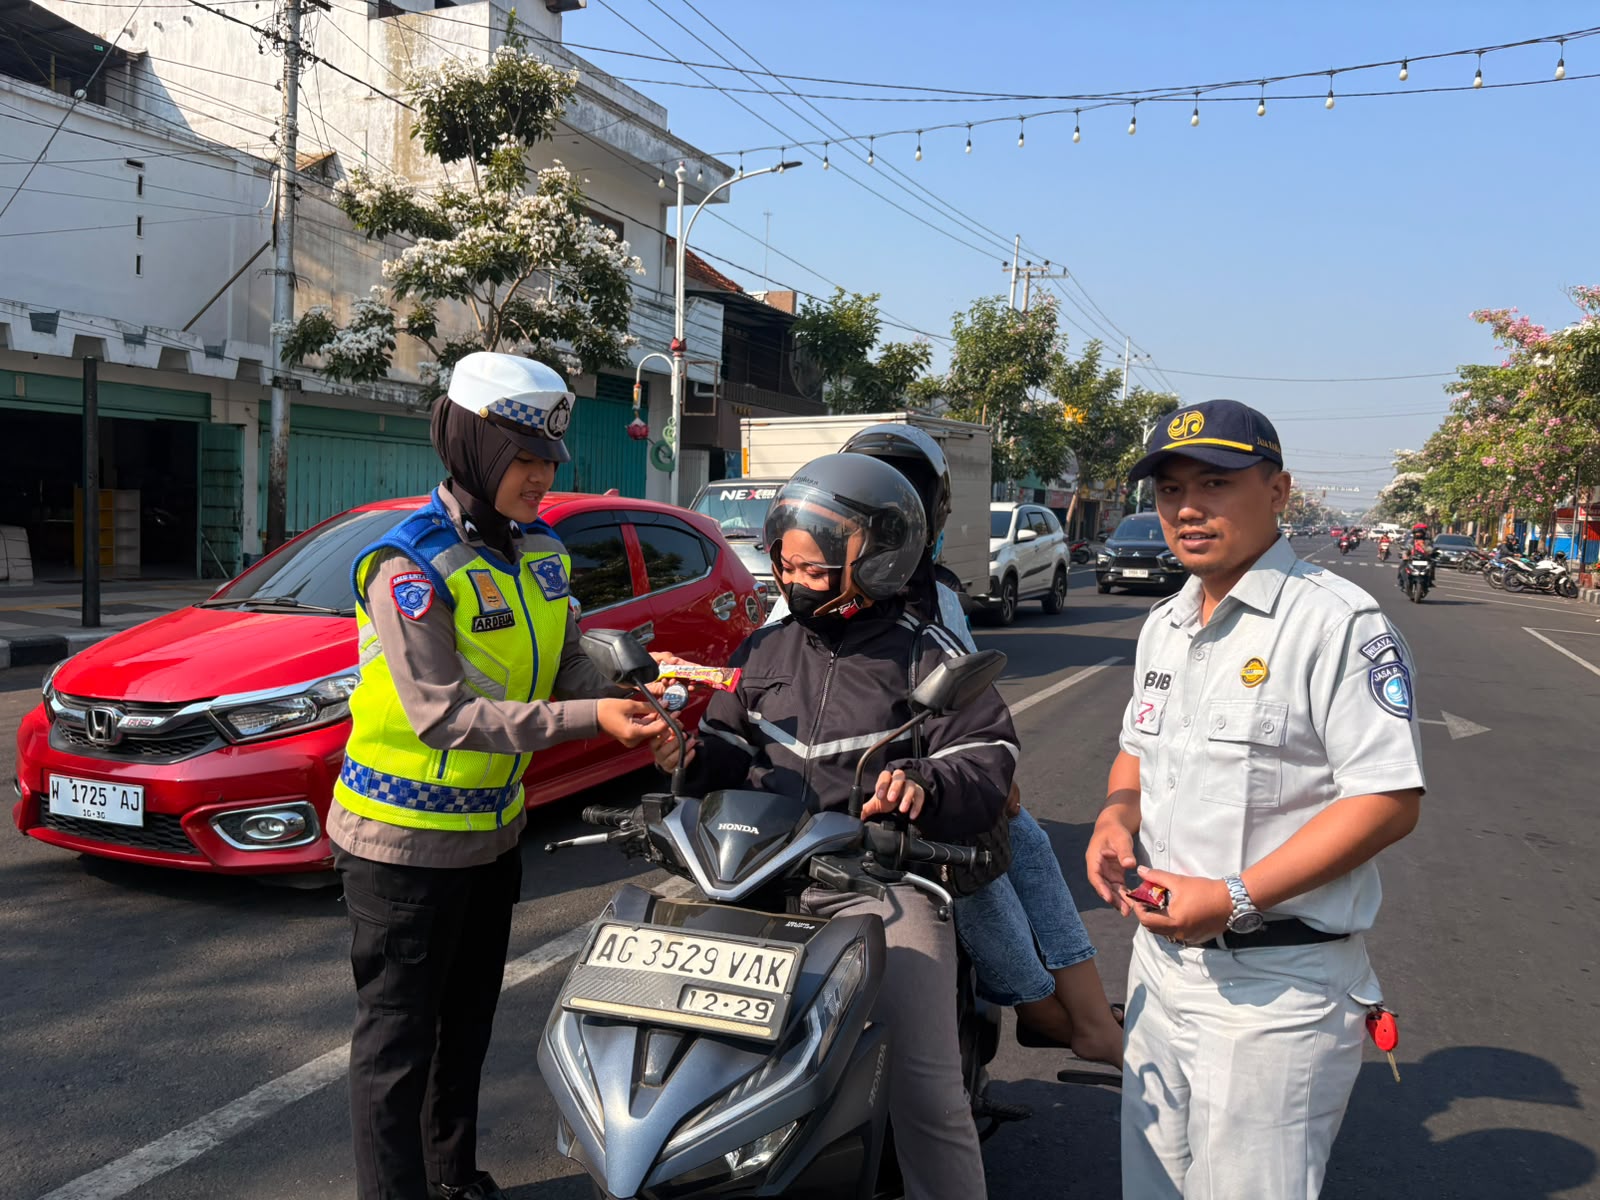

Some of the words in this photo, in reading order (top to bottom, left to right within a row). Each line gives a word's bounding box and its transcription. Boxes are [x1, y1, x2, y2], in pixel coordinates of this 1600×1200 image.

[51, 780, 60, 800] W
[71, 783, 107, 807] 1725
[120, 790, 140, 811] AJ
[718, 822, 760, 835] HONDA
[596, 933, 638, 964] AG
[642, 938, 720, 976] 3529
[728, 950, 787, 988] VAK
[868, 1043, 887, 1109] HONDA
